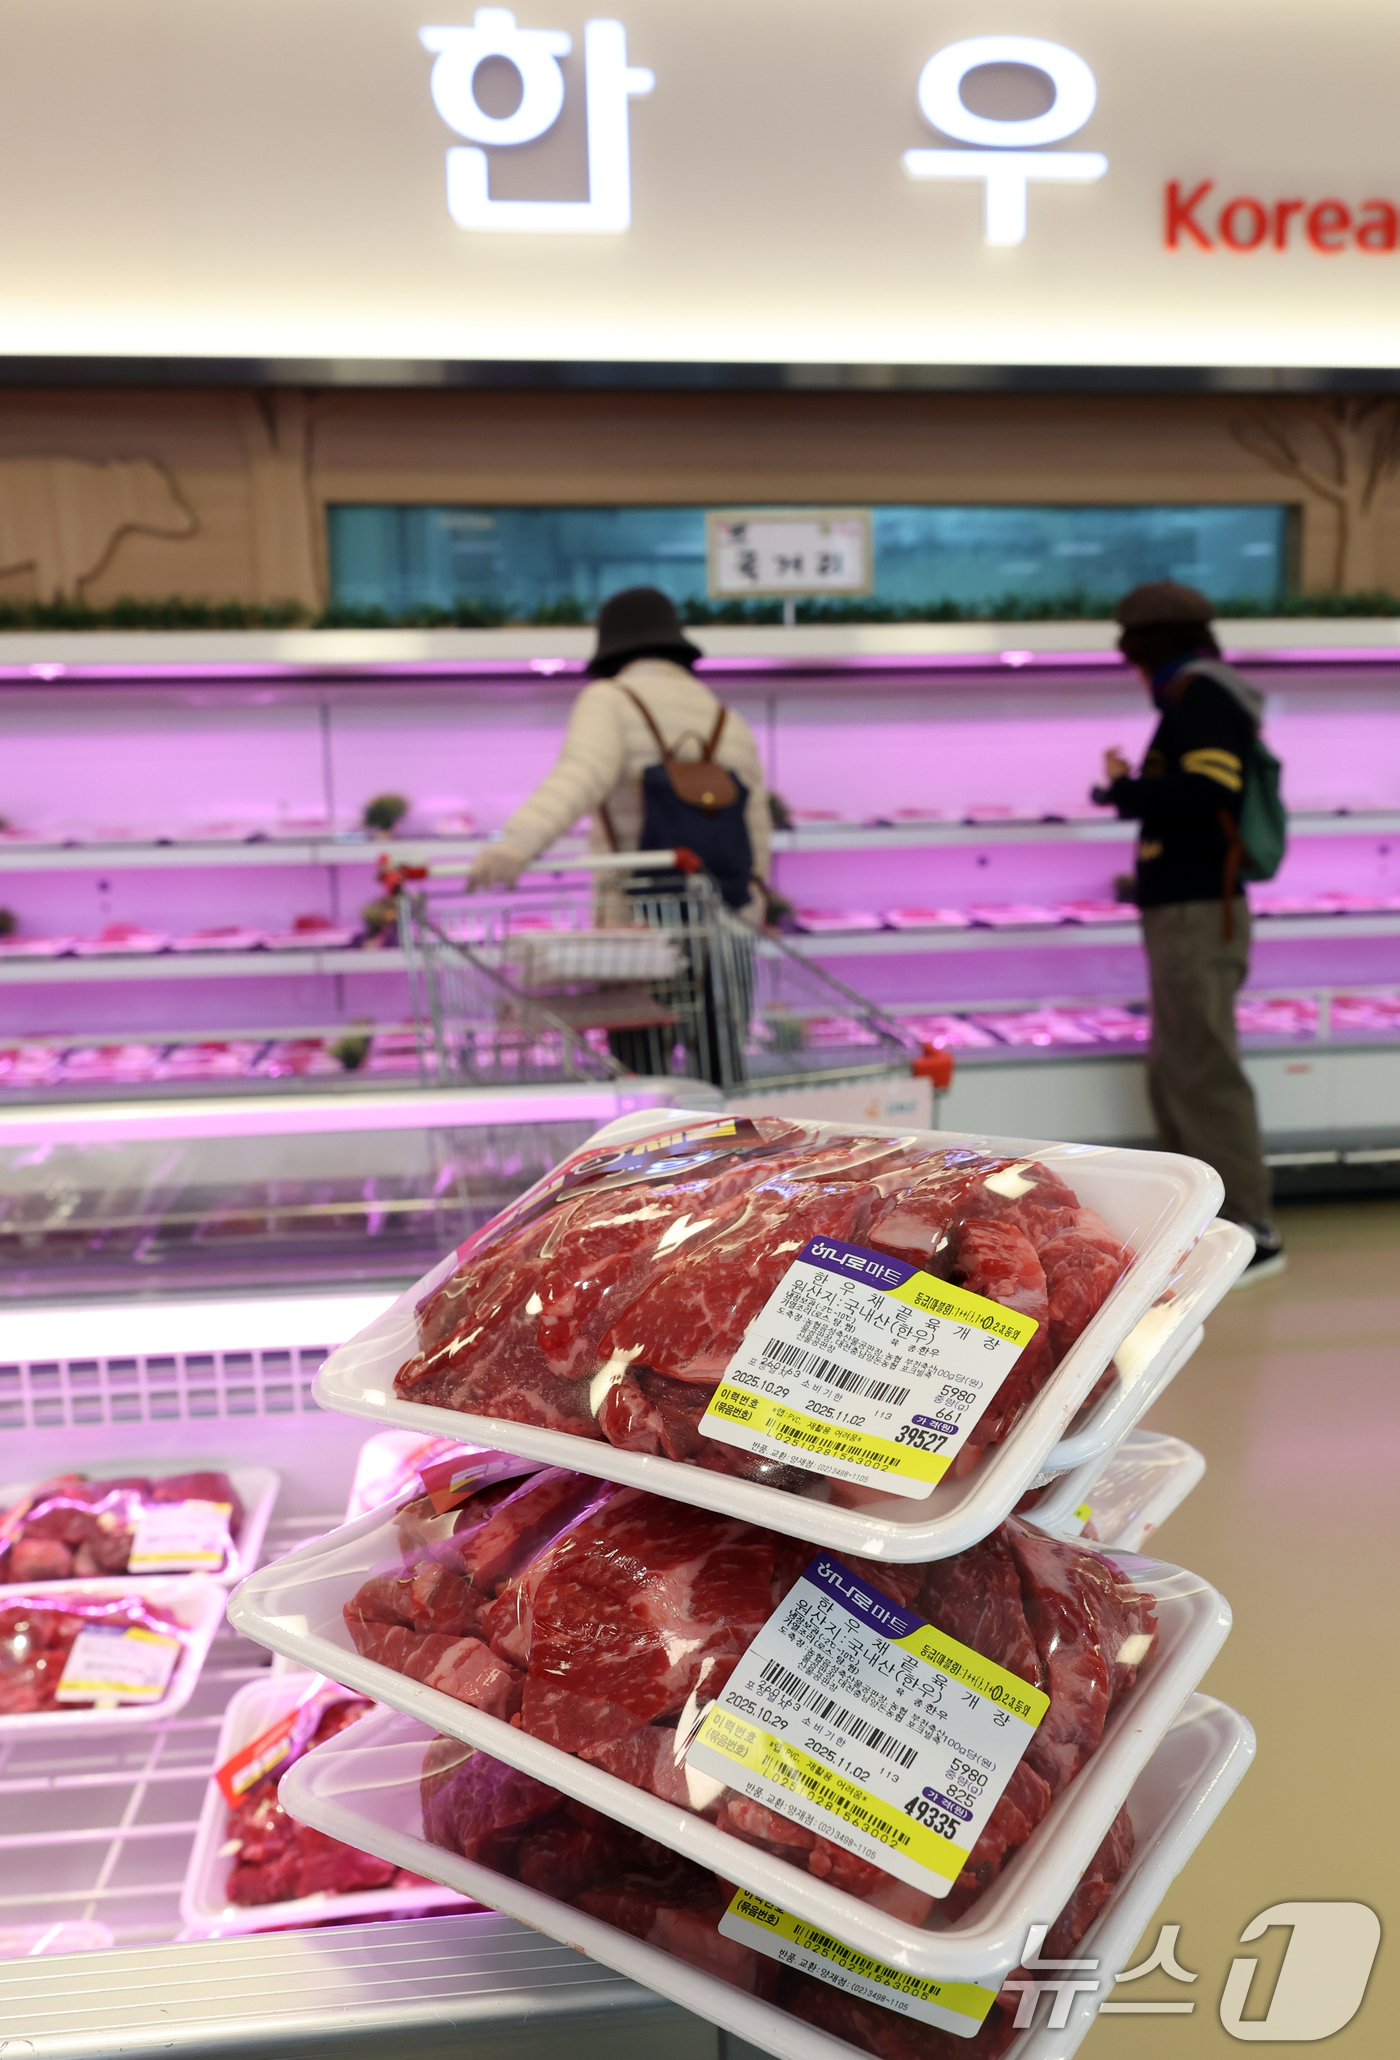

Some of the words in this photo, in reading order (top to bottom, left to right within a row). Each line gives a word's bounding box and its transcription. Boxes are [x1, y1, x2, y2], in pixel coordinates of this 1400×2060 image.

[1163, 178, 1400, 255] Korea
[809, 1241, 904, 1286] 하나로마트
[718, 1388, 760, 1409] 이력번호
[730, 1369, 791, 1398] 2025.10.29
[803, 1399, 866, 1427] 2025.11.02
[873, 1409, 893, 1420] 113
[938, 1384, 977, 1404] 5980
[711, 1400, 753, 1421] (묶음번호)
[934, 1406, 962, 1423] 661
[805, 1421, 831, 1435] 재활용
[893, 1423, 948, 1455] 39527
[813, 1559, 909, 1636] 하나로마트
[703, 1727, 750, 1759] (묶음번호)
[711, 1713, 758, 1745] 이력번호
[725, 1690, 789, 1732] 2025.10.29
[802, 1737, 871, 1783] 2025.11.02
[878, 1766, 900, 1783] 113
[804, 1760, 834, 1782] 재활용
[949, 1757, 988, 1787] 5980
[945, 1783, 976, 1808] 825
[900, 1793, 962, 1841] 49335
[736, 1899, 780, 1927] (묶음번호)
